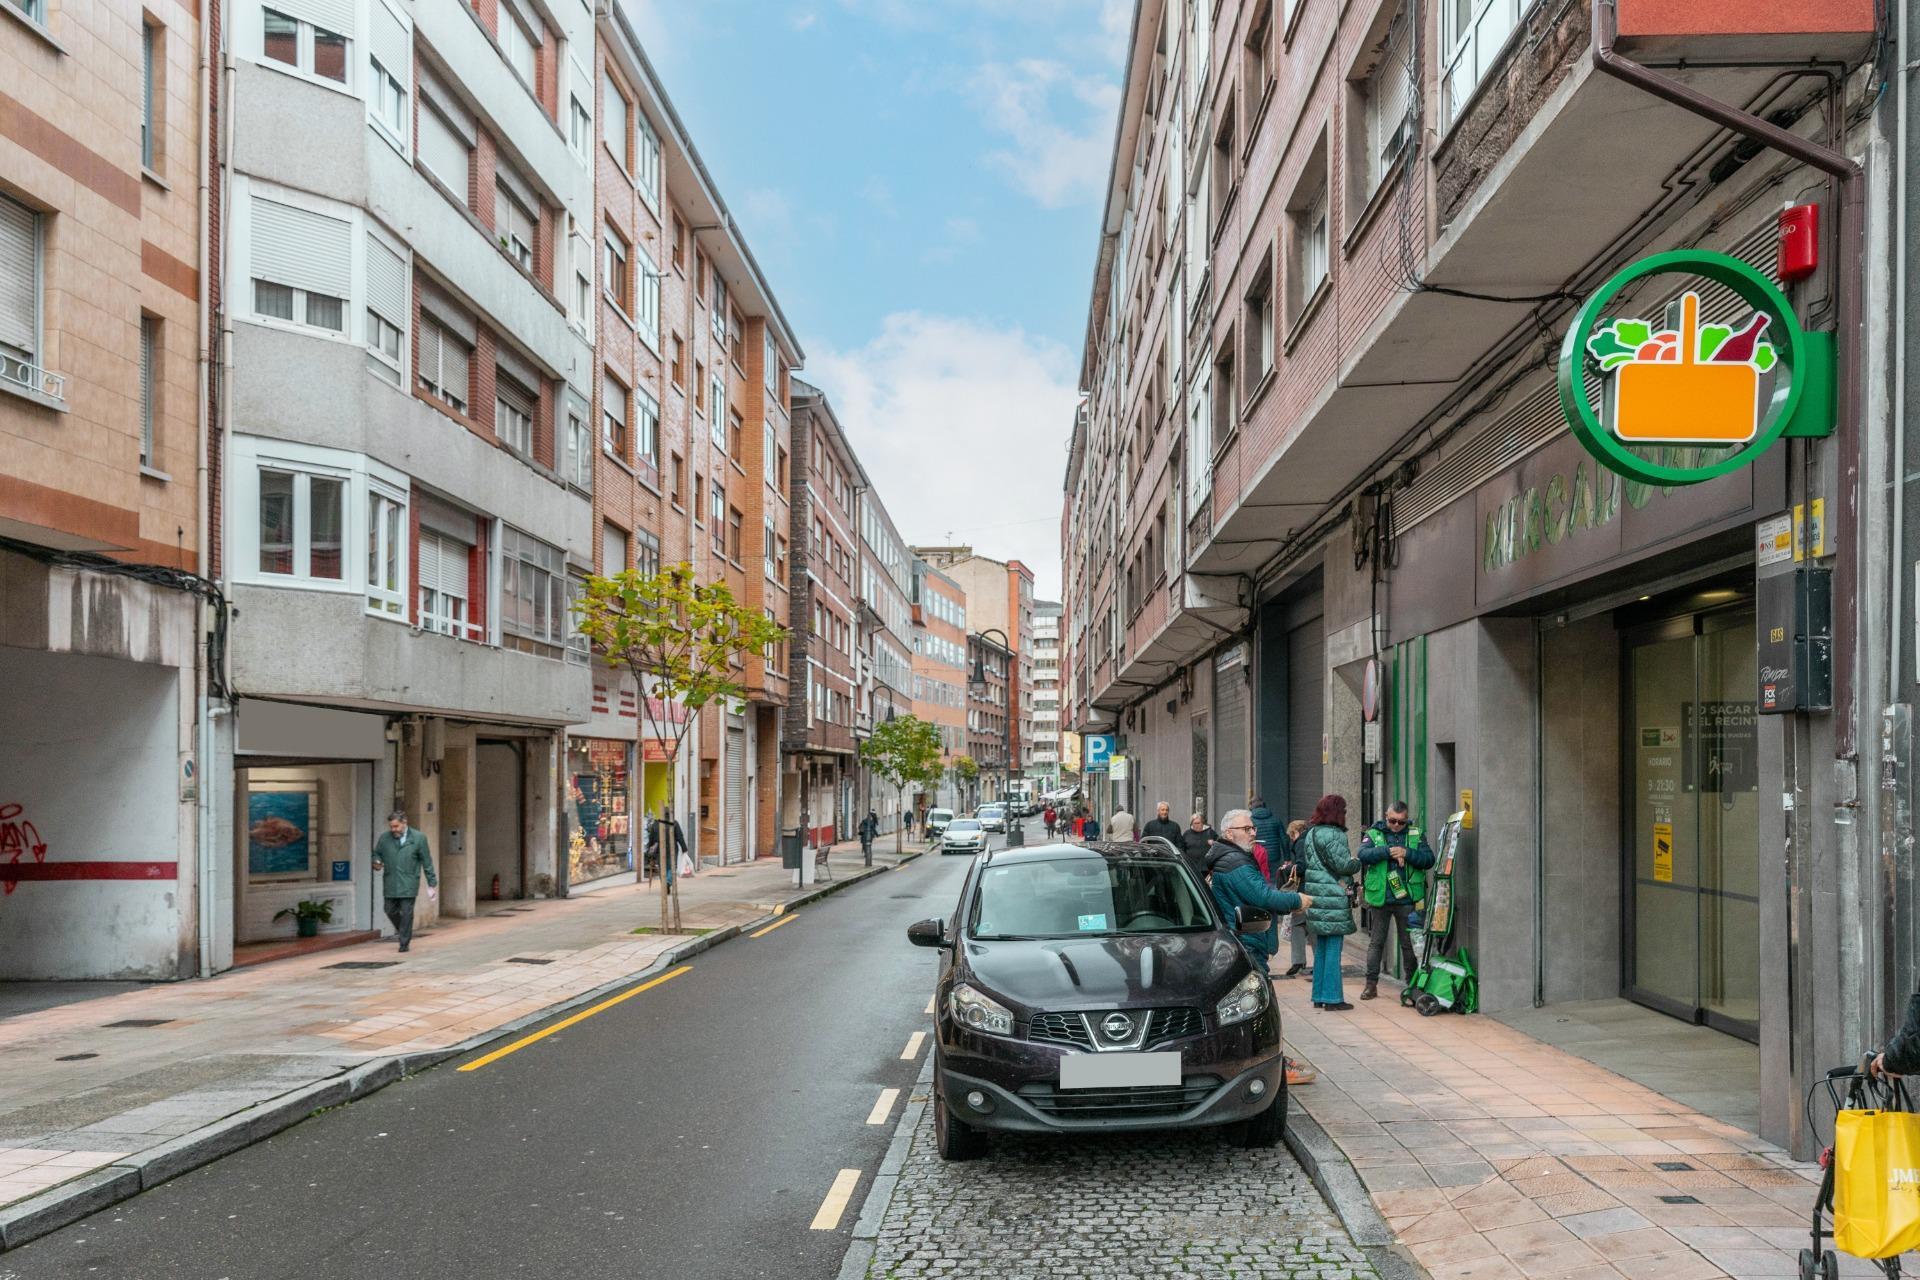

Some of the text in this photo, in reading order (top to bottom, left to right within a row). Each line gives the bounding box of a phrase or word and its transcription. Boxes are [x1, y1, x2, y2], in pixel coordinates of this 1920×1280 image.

[1771, 628, 1783, 642] GAS
[1710, 705, 1751, 715] SACAR
[1087, 736, 1107, 764] P
